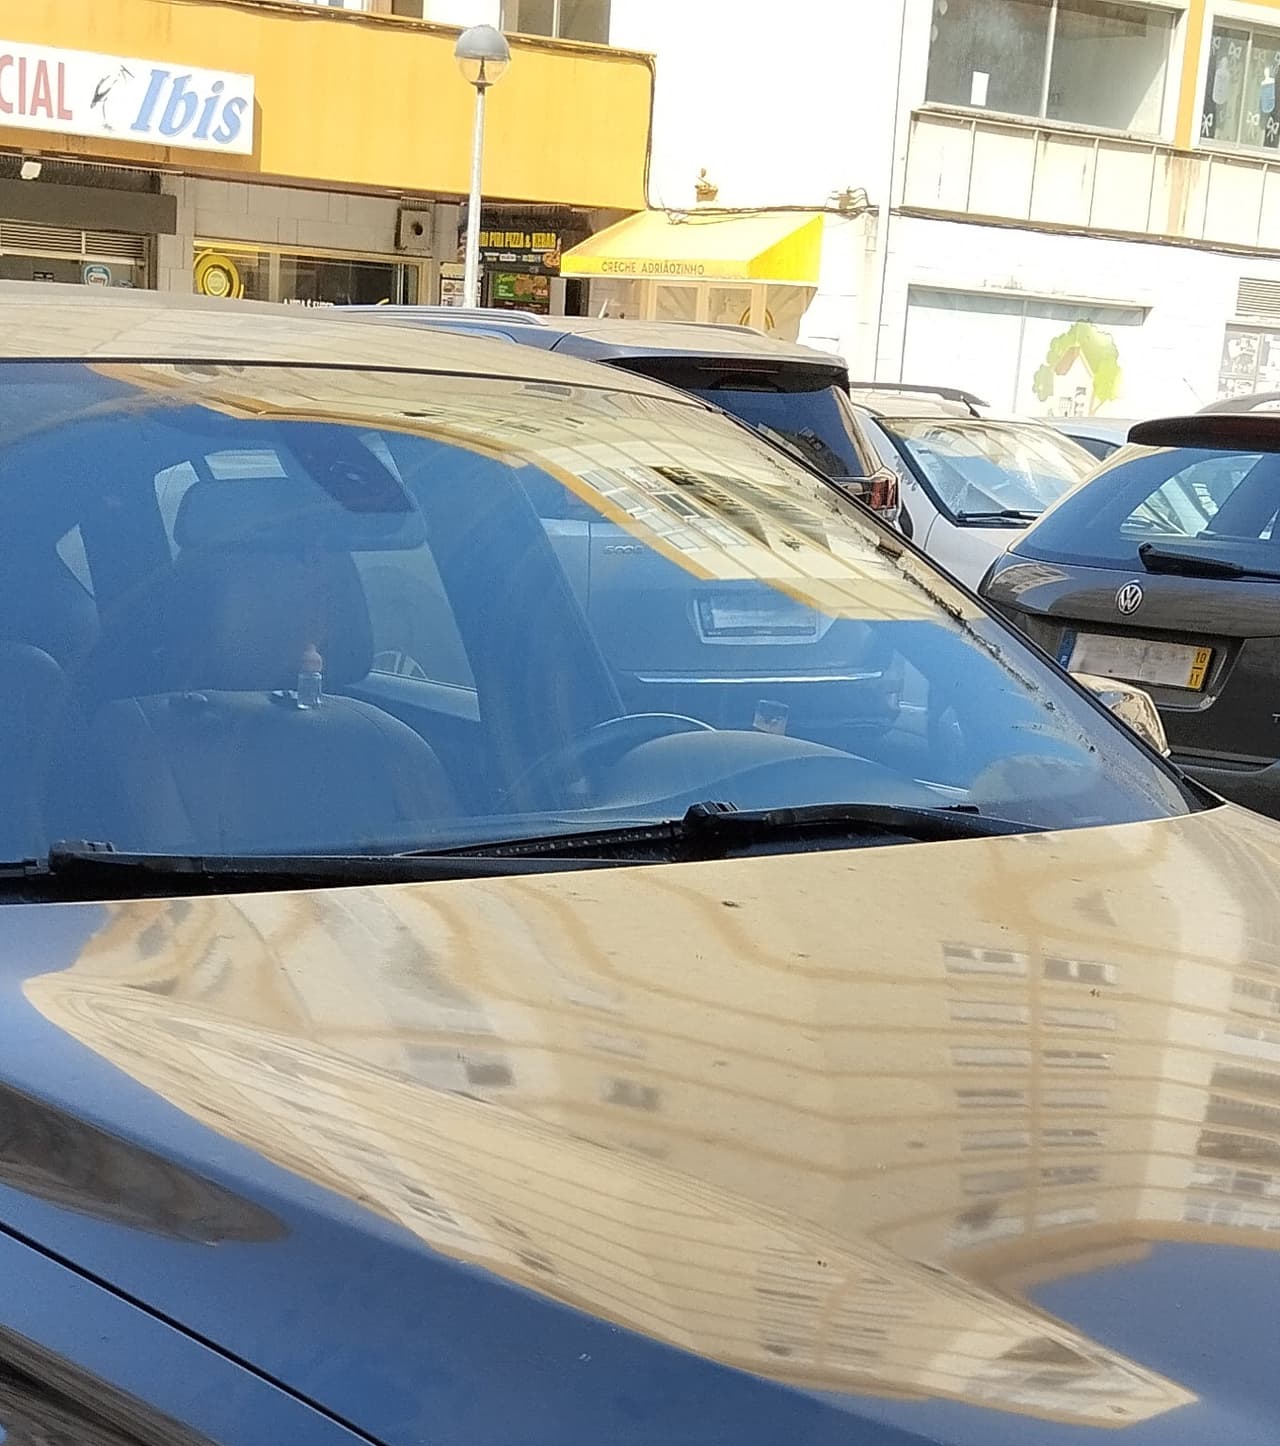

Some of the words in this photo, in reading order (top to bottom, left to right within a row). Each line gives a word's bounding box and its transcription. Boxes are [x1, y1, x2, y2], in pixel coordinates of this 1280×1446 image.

[130, 69, 249, 145] Ibis
[601, 261, 637, 273] CRECHE
[1196, 651, 1208, 664] 10
